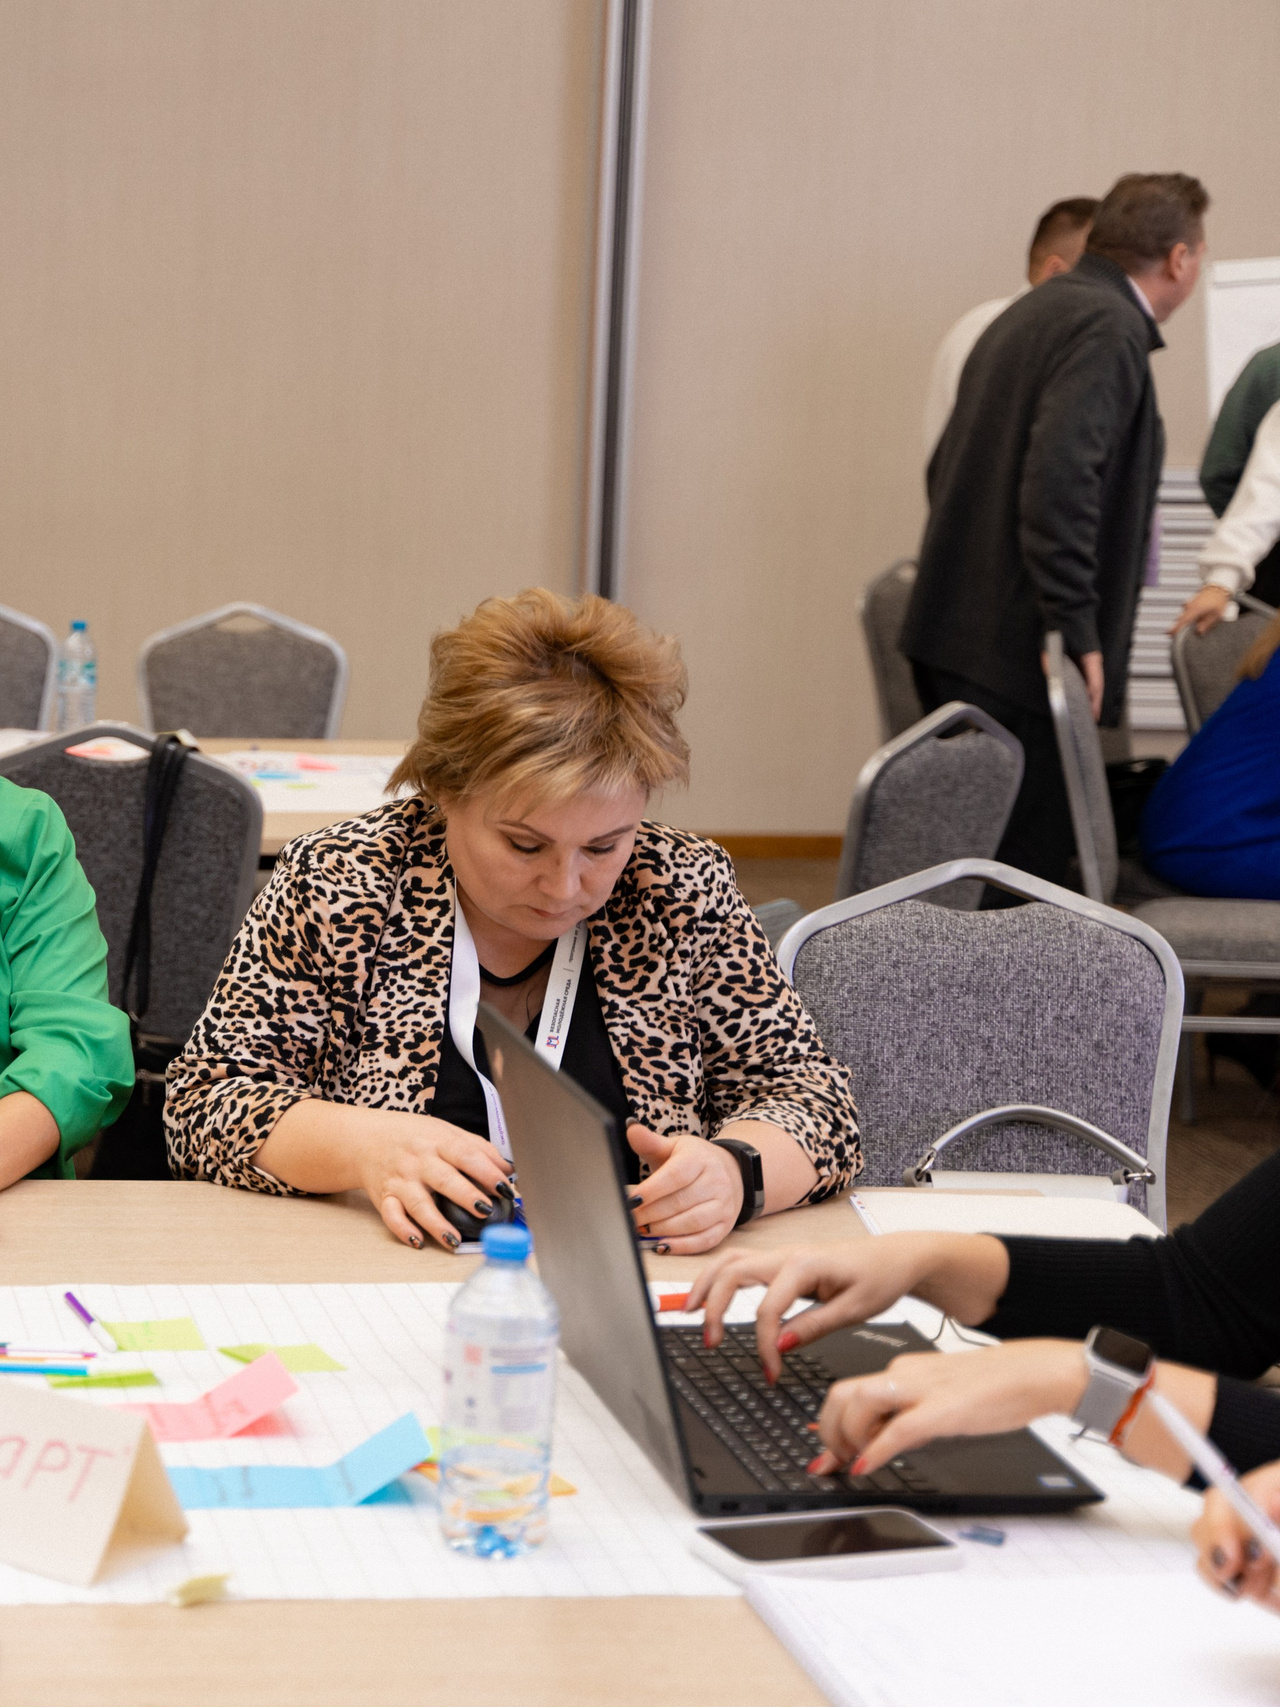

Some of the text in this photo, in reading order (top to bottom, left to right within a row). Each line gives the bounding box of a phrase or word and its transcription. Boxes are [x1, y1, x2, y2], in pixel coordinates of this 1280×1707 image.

[550, 998, 561, 1033] БЕЗОПАСНАЯ
[556, 978, 572, 1034] МОЛОДЁЖНАЯ СРЕДА
